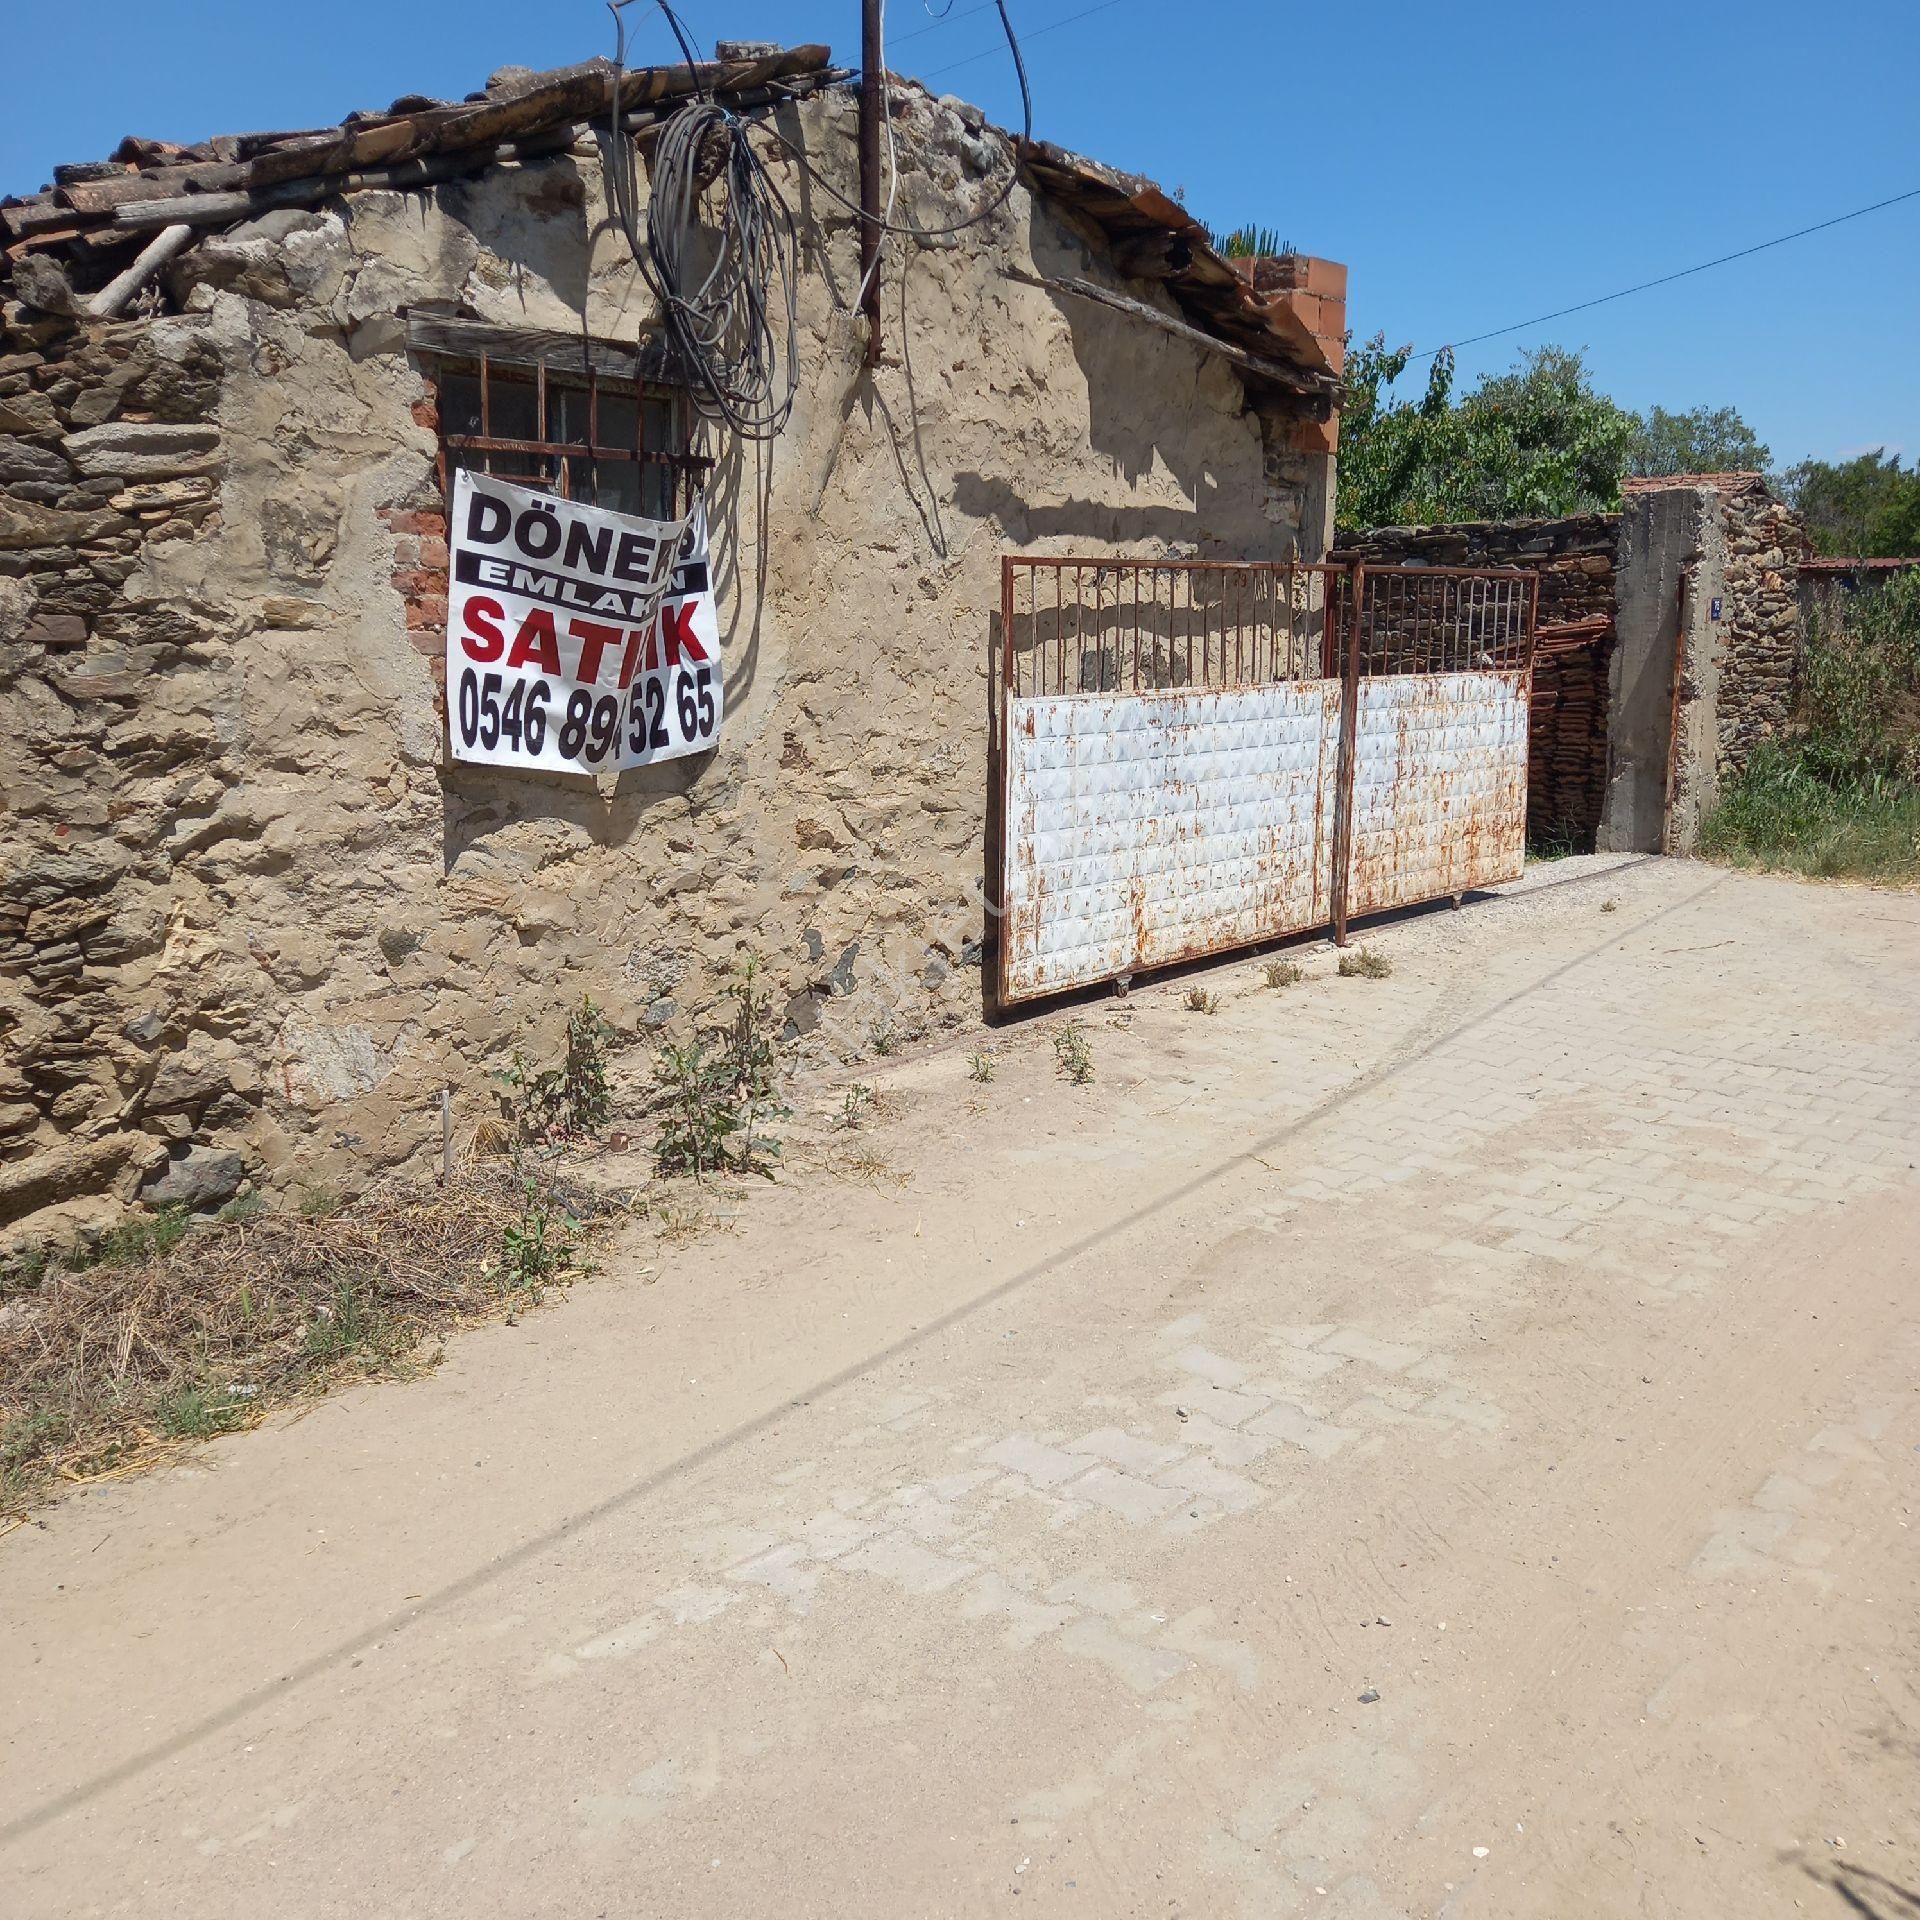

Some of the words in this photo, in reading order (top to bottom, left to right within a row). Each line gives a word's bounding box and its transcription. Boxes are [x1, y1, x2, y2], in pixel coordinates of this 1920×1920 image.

[459, 667, 551, 756] 0546
[629, 676, 670, 754] 52
[676, 668, 715, 743] 65
